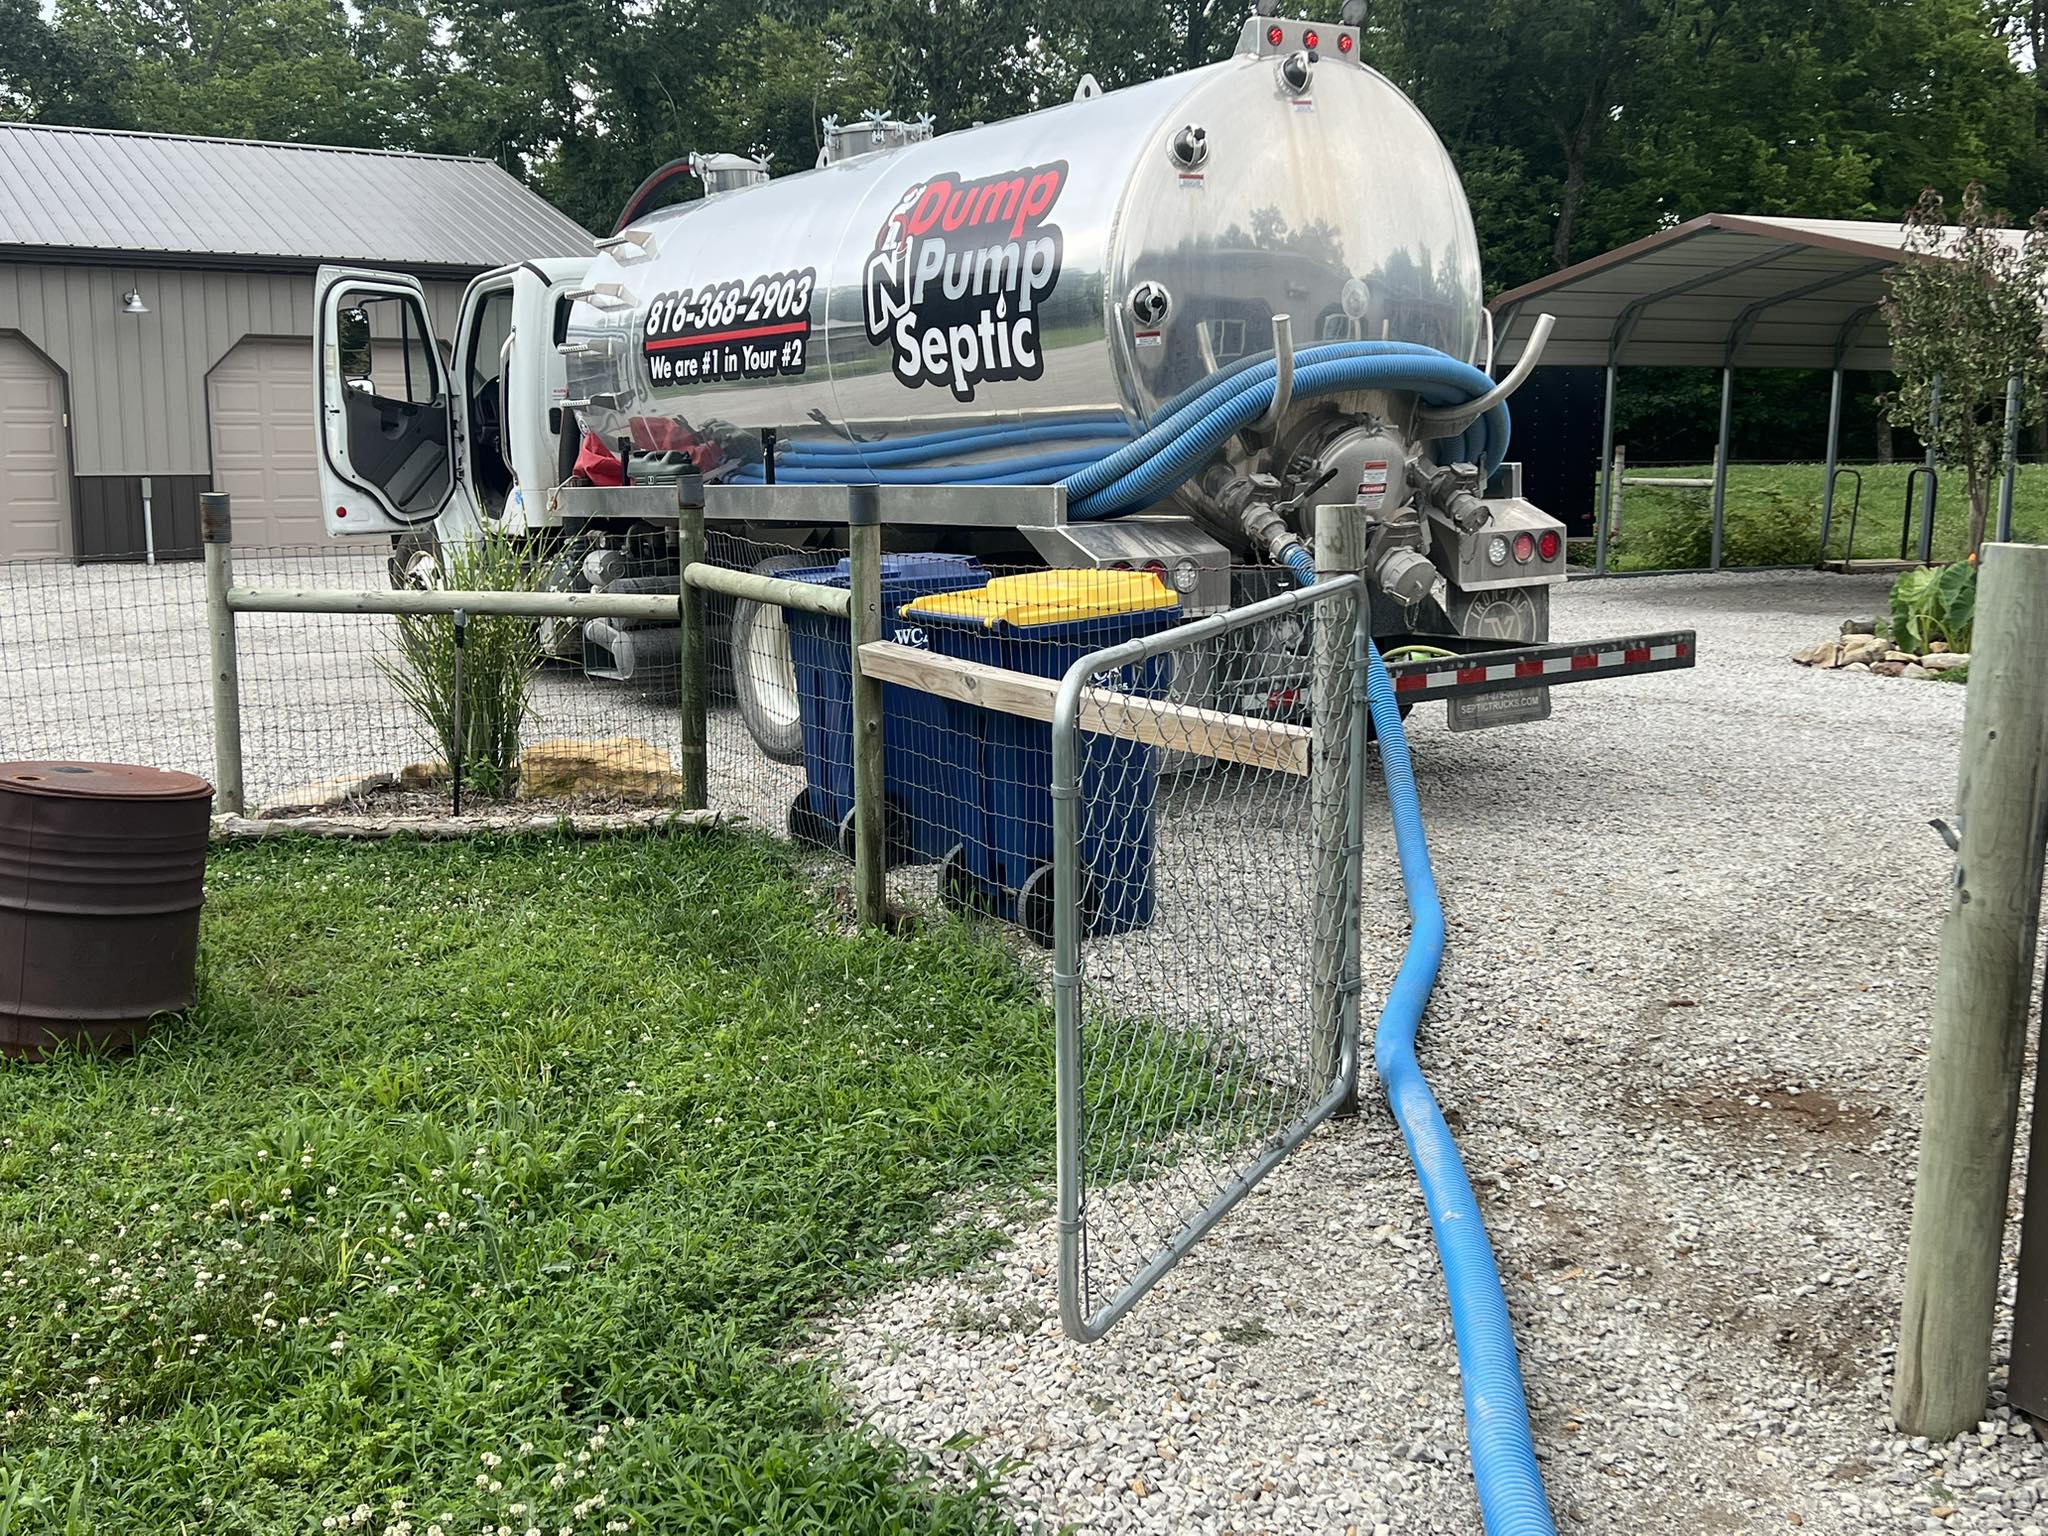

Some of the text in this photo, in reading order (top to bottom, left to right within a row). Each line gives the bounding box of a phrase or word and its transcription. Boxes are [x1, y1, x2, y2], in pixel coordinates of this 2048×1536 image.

[908, 170, 1060, 240] Dump
[646, 275, 812, 336] 816-368-2903
[912, 237, 1056, 312] Pump
[650, 338, 802, 380] We are #1 in Your #2
[896, 292, 1036, 392] Septic
[1460, 695, 1540, 715] SEPTICTRUCKS.COM
